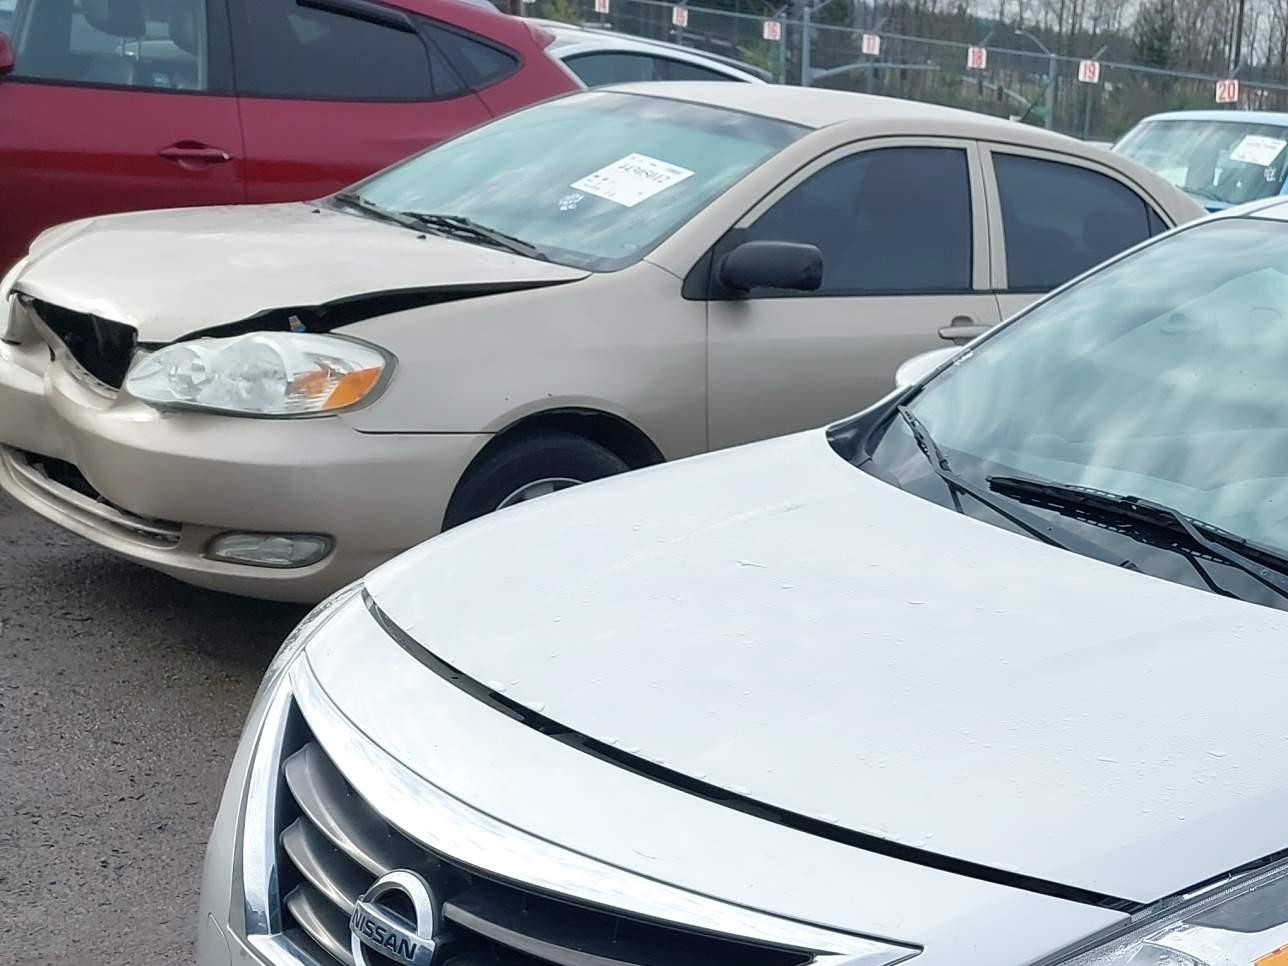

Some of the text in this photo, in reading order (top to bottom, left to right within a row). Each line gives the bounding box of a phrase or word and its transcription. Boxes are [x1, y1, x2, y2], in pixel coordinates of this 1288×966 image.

[971, 49, 983, 68] 18
[1082, 61, 1096, 80] 19
[1218, 81, 1237, 100] 20
[351, 907, 418, 962] NISSAN
